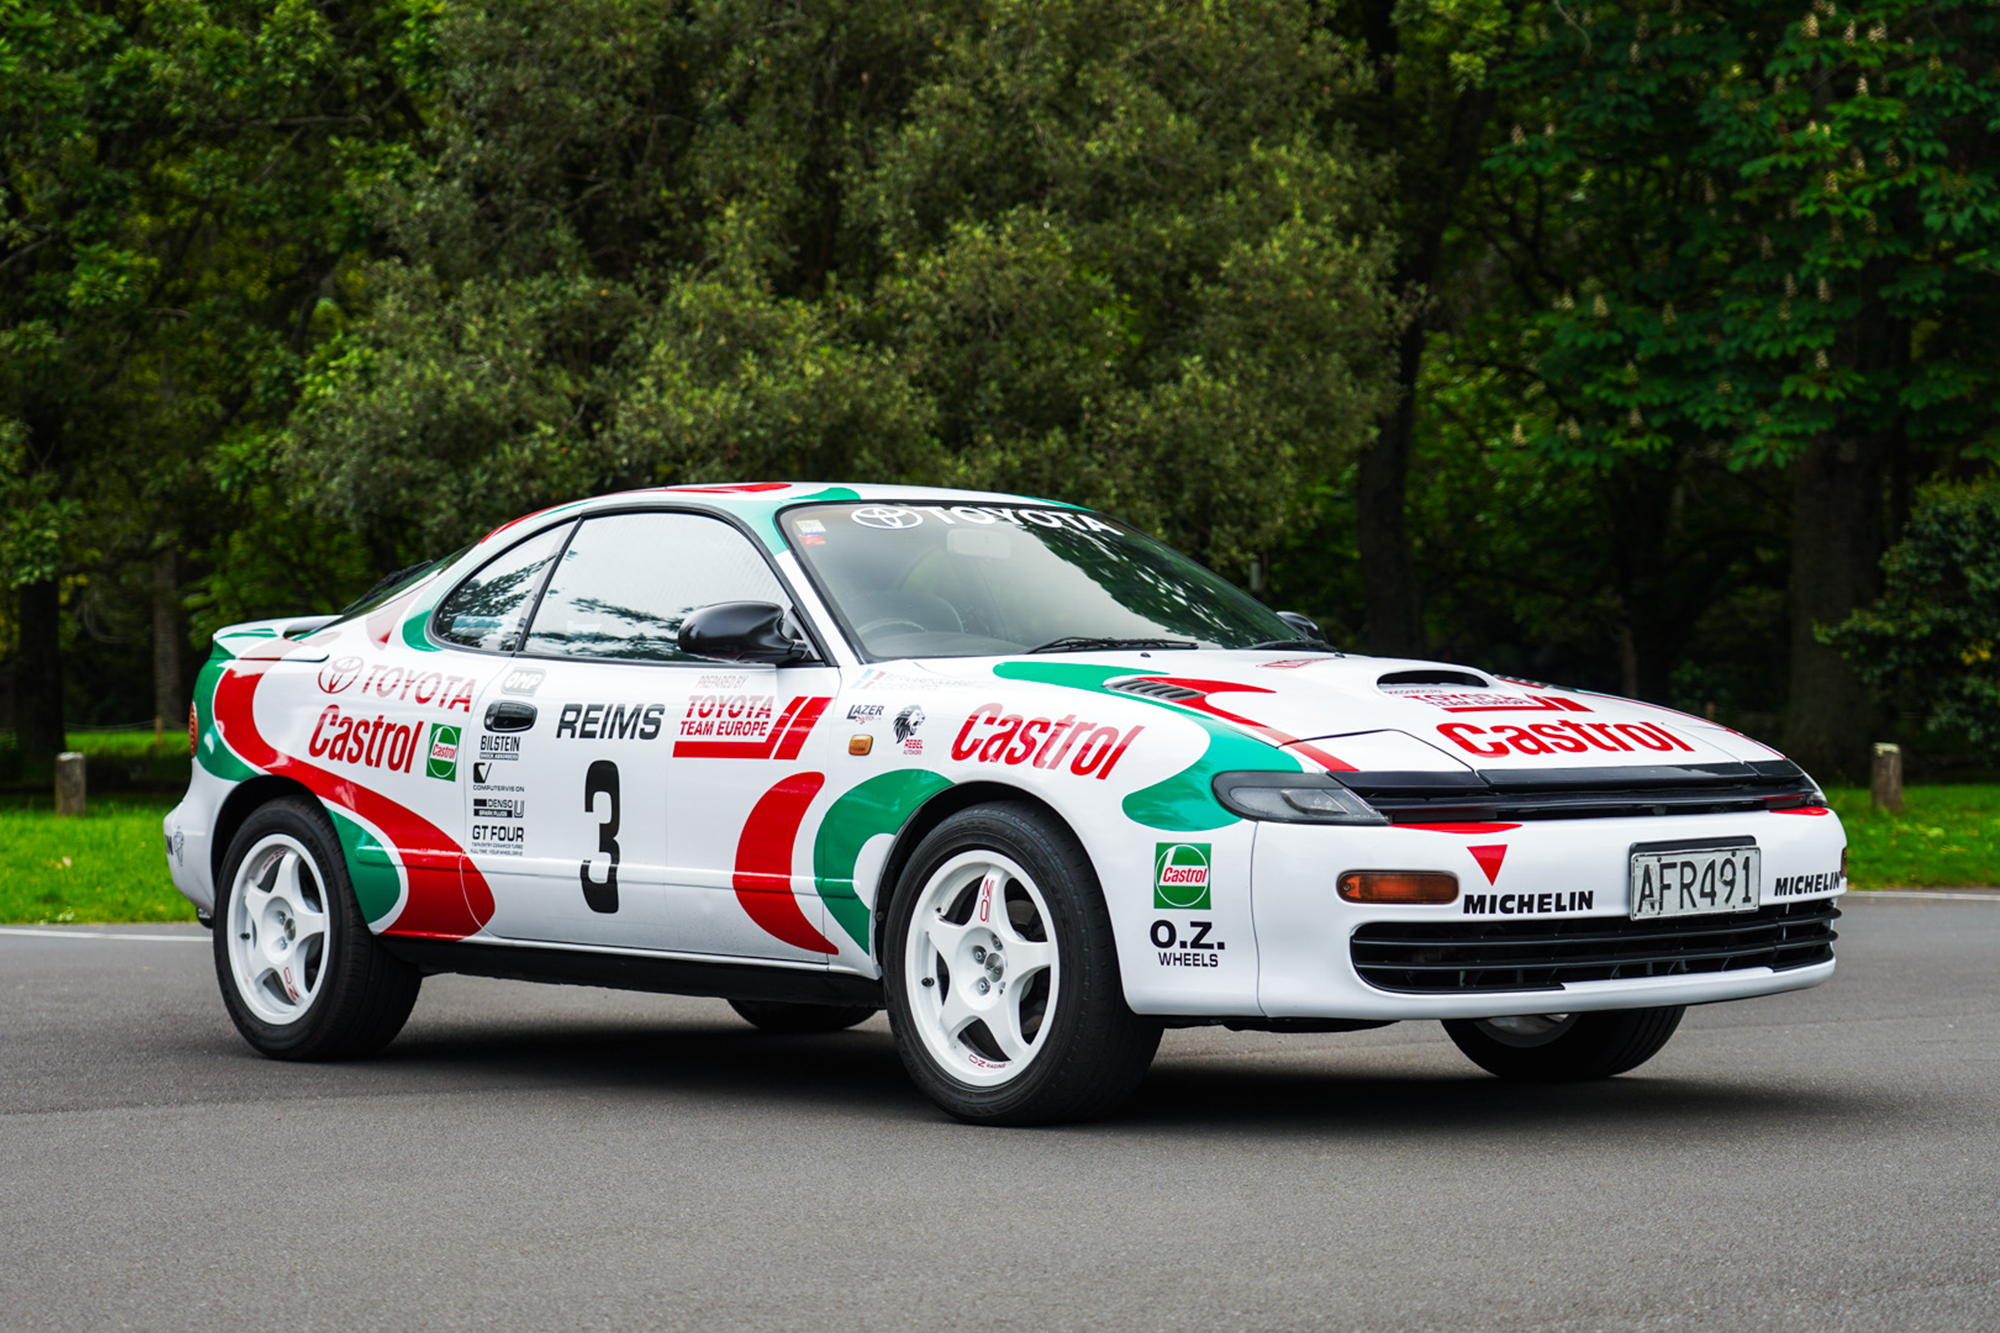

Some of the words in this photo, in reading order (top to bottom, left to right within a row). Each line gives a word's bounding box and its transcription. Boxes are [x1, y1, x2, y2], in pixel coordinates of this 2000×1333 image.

[914, 505, 1125, 537] TOYOTA
[361, 664, 477, 713] TOYOTA
[504, 672, 543, 690] OMP
[686, 695, 774, 719] TOYOTA
[846, 704, 885, 720] LAZER
[556, 703, 665, 740] REIMS
[680, 721, 714, 736] TEAM
[716, 721, 769, 737] EUROPE
[308, 704, 425, 774] Castrol
[432, 743, 457, 759] Castrol
[480, 735, 521, 752] BILSTEIN
[951, 702, 1146, 781] Castrol
[1435, 719, 1696, 759] Castrol
[488, 799, 513, 808] DENSO
[473, 825, 488, 840] GT
[490, 826, 524, 842] FOUR
[580, 759, 621, 914] 3
[1162, 867, 1208, 883] Castrol
[1637, 855, 1752, 914] AFR491
[1774, 870, 1842, 896] MICHELIN
[1463, 890, 1594, 915] MICHELIN
[1150, 919, 1225, 950] O.Z.
[1158, 952, 1219, 967] WHEELS
